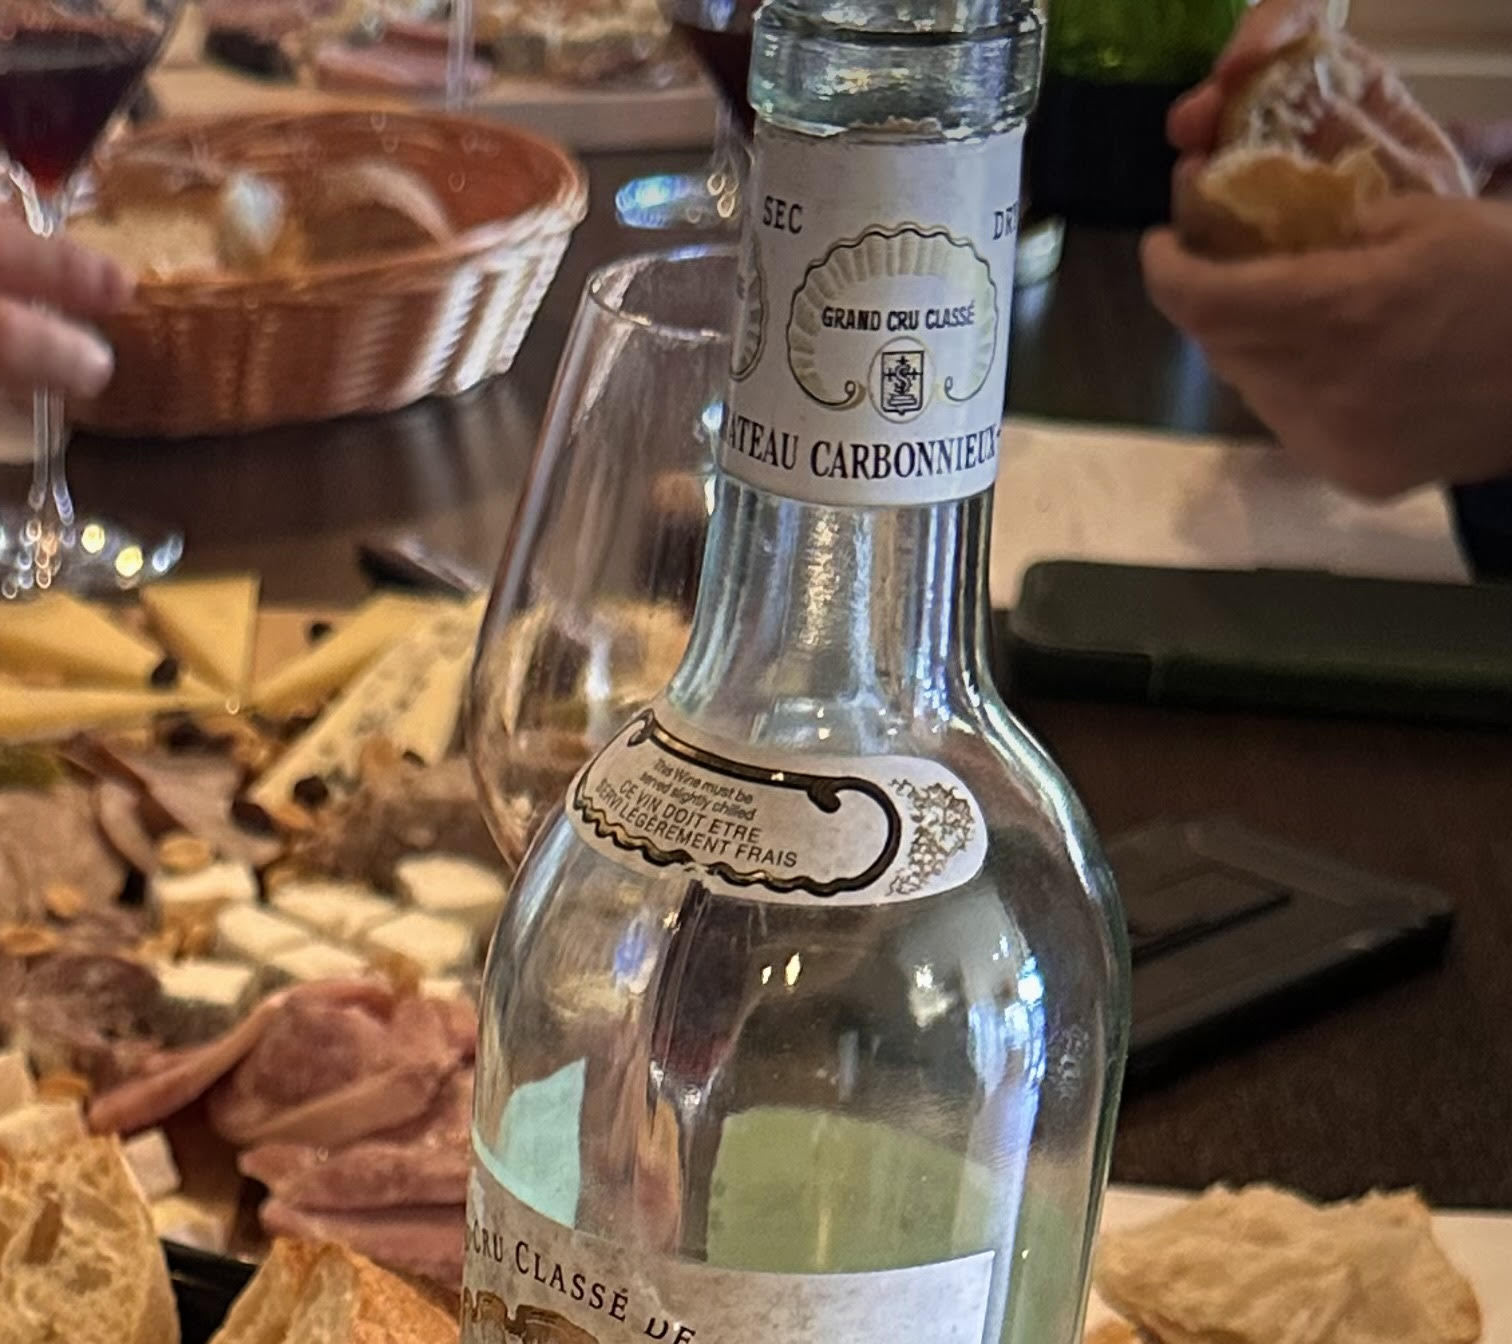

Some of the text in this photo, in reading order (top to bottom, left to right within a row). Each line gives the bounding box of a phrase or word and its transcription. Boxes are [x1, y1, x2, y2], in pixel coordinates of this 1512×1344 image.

[763, 196, 803, 235] SEC
[822, 300, 976, 332] GRAND CRU CLASSÉ
[673, 764, 701, 788] Wine
[619, 779, 639, 800] CE
[639, 791, 661, 813] VIN
[662, 803, 707, 829] DOIT
[734, 843, 798, 868] FRAIS
[515, 1240, 629, 1322] CLASSÉ
